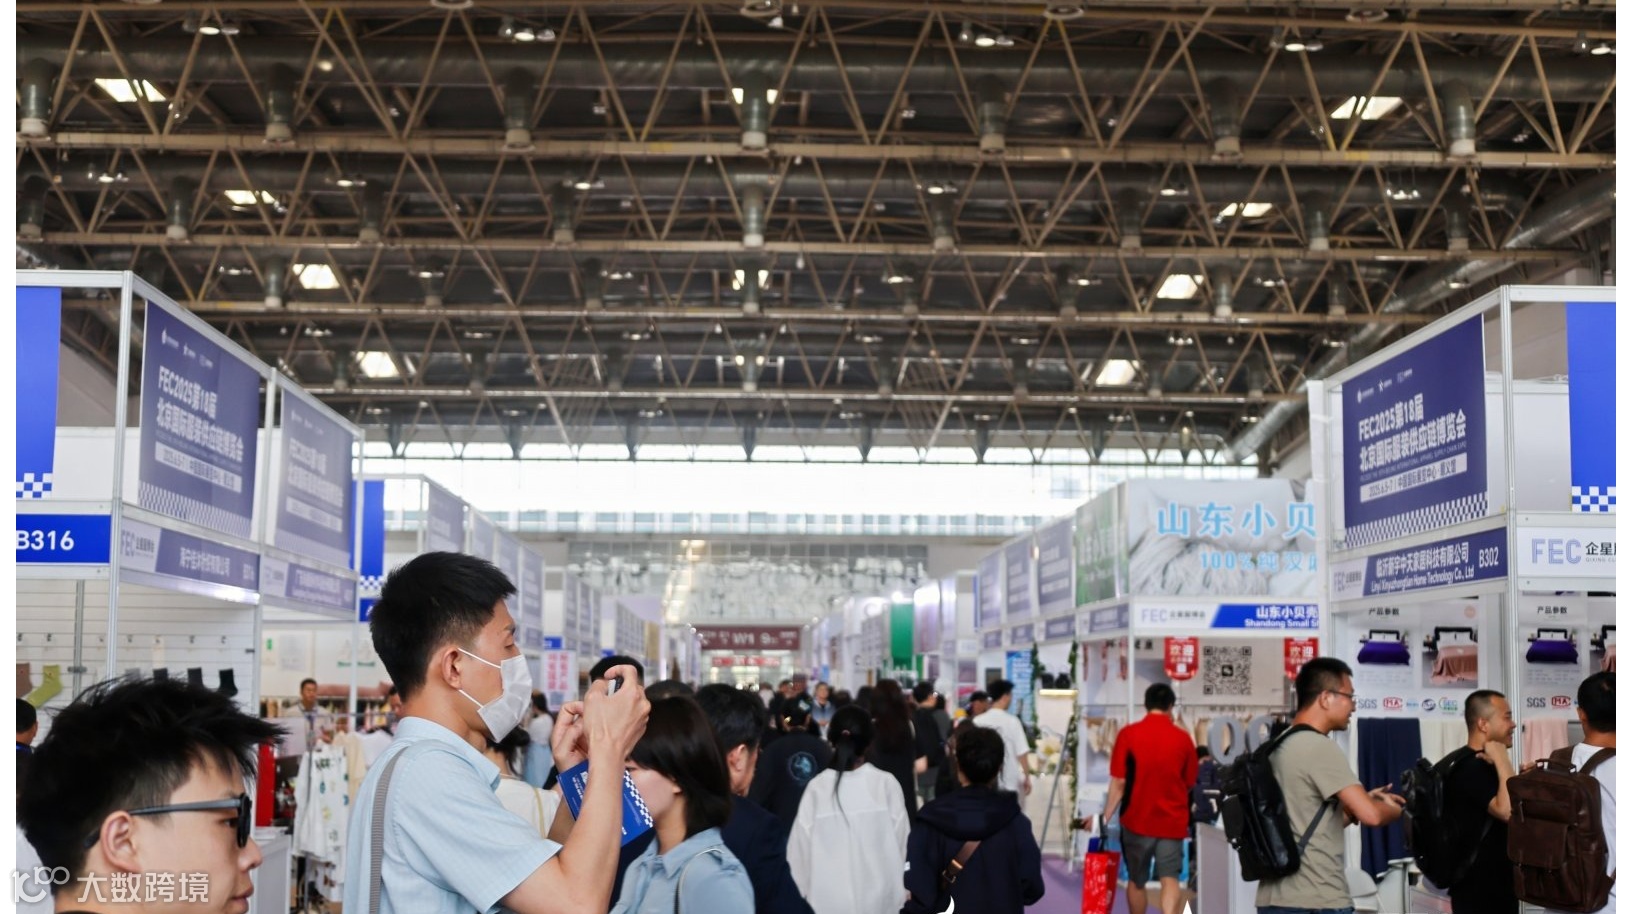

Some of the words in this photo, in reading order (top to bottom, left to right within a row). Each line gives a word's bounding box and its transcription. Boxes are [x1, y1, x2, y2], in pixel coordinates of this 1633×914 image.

[1359, 393, 1424, 441] FEC2025第18届
[1360, 408, 1466, 473] 北京国际服装供应链博览会
[1158, 502, 1317, 538] 山东小贝
[16, 529, 75, 551] B316
[1585, 541, 1616, 556] 企星
[1479, 546, 1499, 568] B302
[1531, 538, 1581, 564] FEC
[1413, 573, 1427, 586] Home
[1427, 569, 1453, 584] Technology
[1465, 565, 1474, 578] Ltd
[1141, 608, 1167, 622] FEC
[1537, 606, 1567, 614] 产品参数
[1245, 619, 1286, 629] Shandong
[1287, 619, 1310, 627] Small
[1358, 699, 1377, 709] SGS
[1526, 697, 1546, 708] SGS
